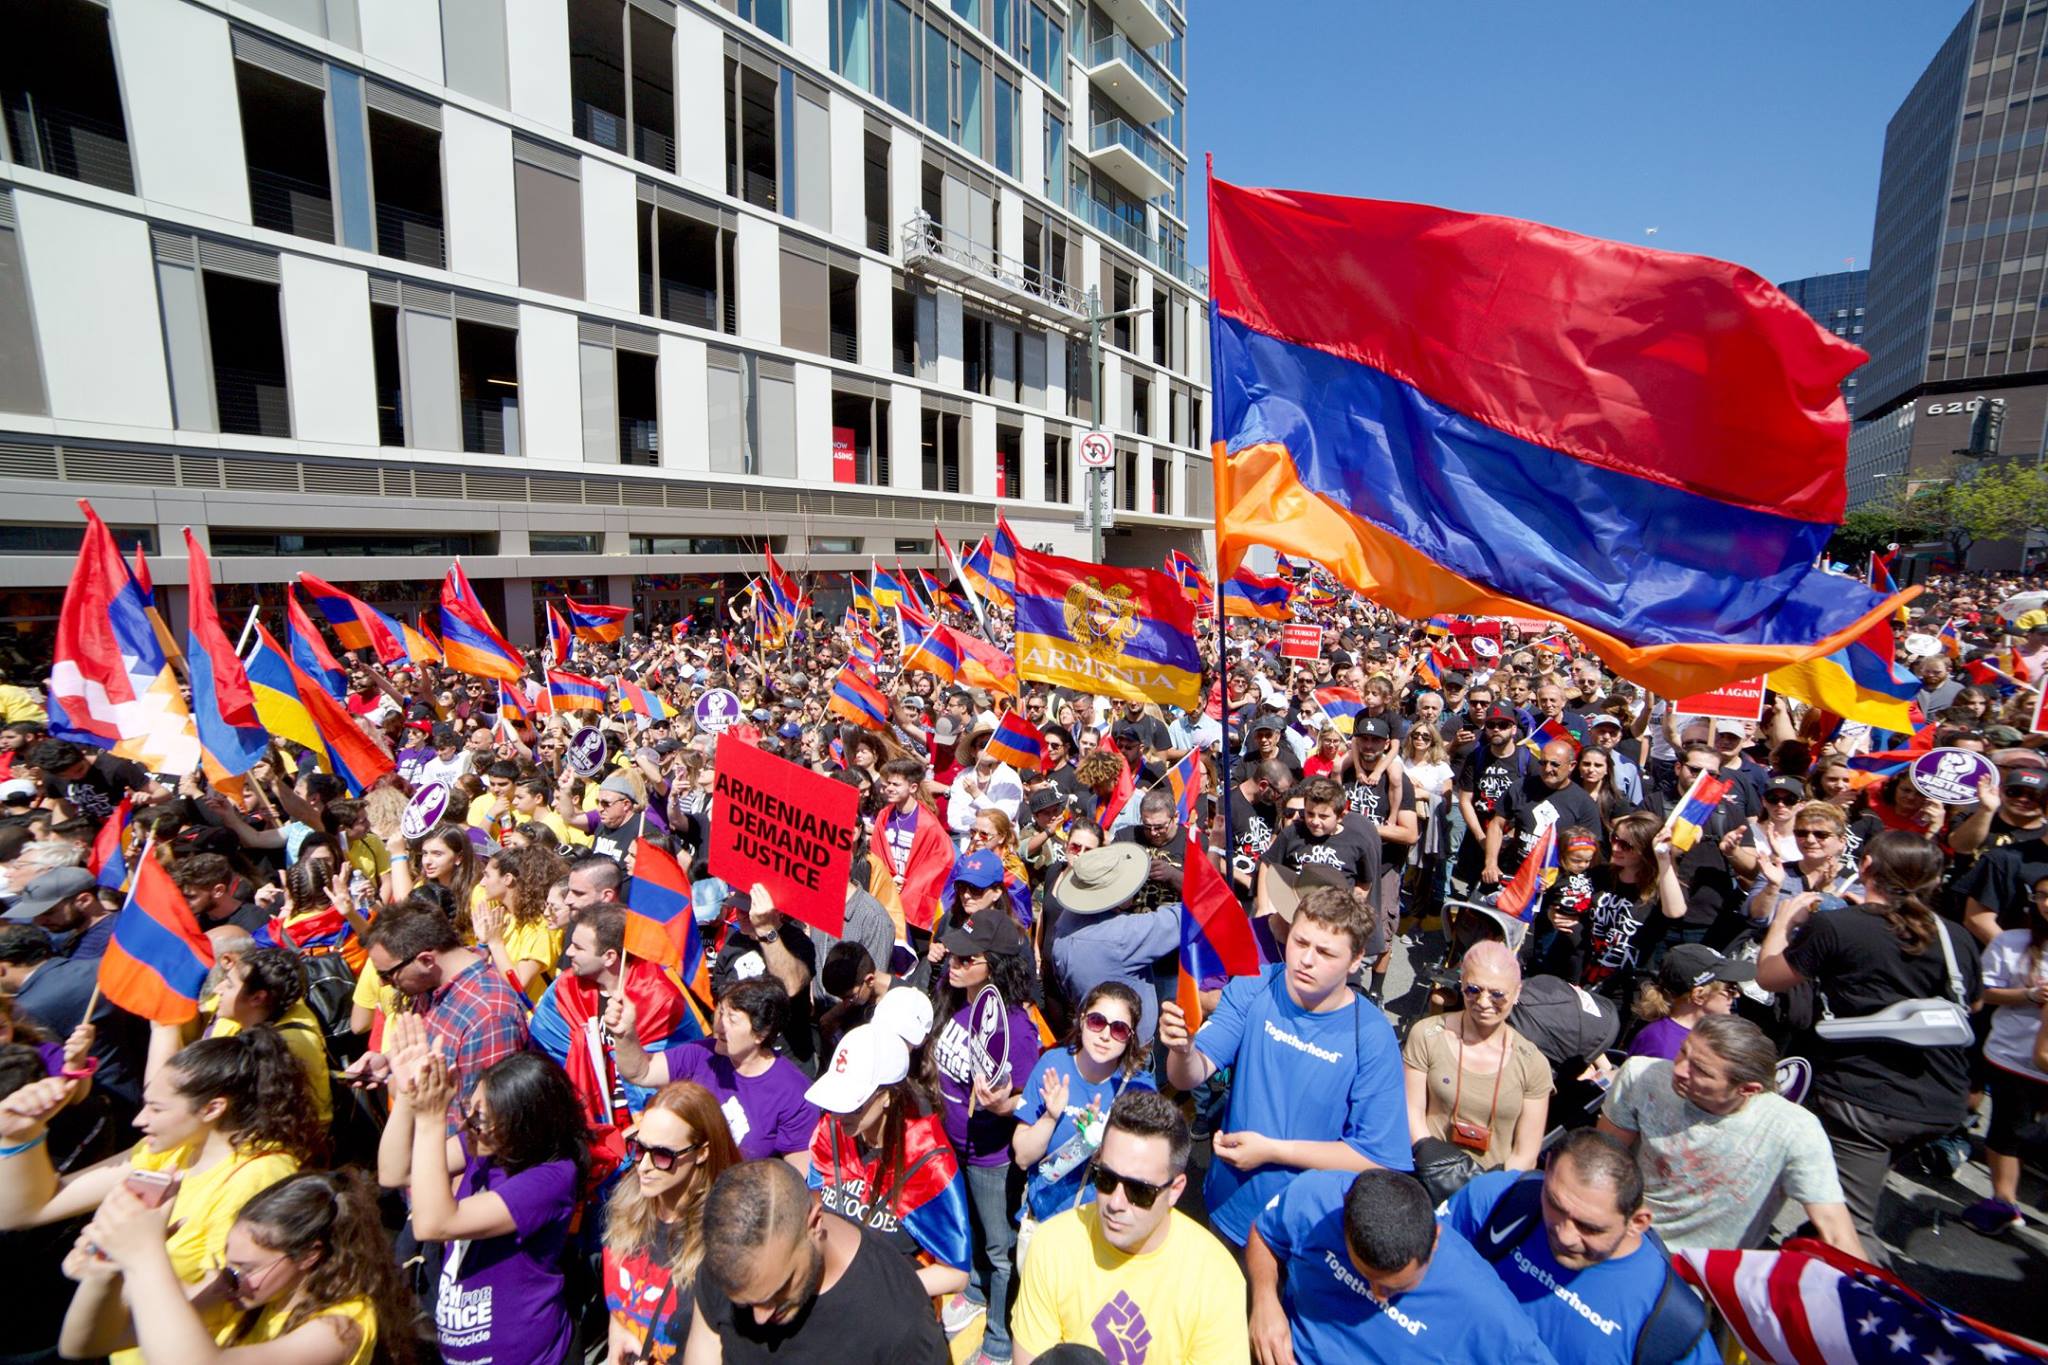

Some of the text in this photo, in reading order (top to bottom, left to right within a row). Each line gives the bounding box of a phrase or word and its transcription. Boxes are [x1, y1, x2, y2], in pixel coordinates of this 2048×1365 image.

[833, 451, 853, 461] ASING
[1022, 647, 1176, 690] ARMENIA
[1725, 687, 1760, 698] AGAIN
[1917, 773, 1978, 798] JUSTICE
[715, 772, 854, 852] ARMENIANS
[728, 803, 830, 868] DEMAND
[732, 832, 821, 892] JUSTICE
[1312, 845, 1338, 860] OUR
[1598, 892, 1634, 919] OUR
[1264, 1019, 1341, 1064] Togetherhood
[435, 1301, 493, 1330] STICE
